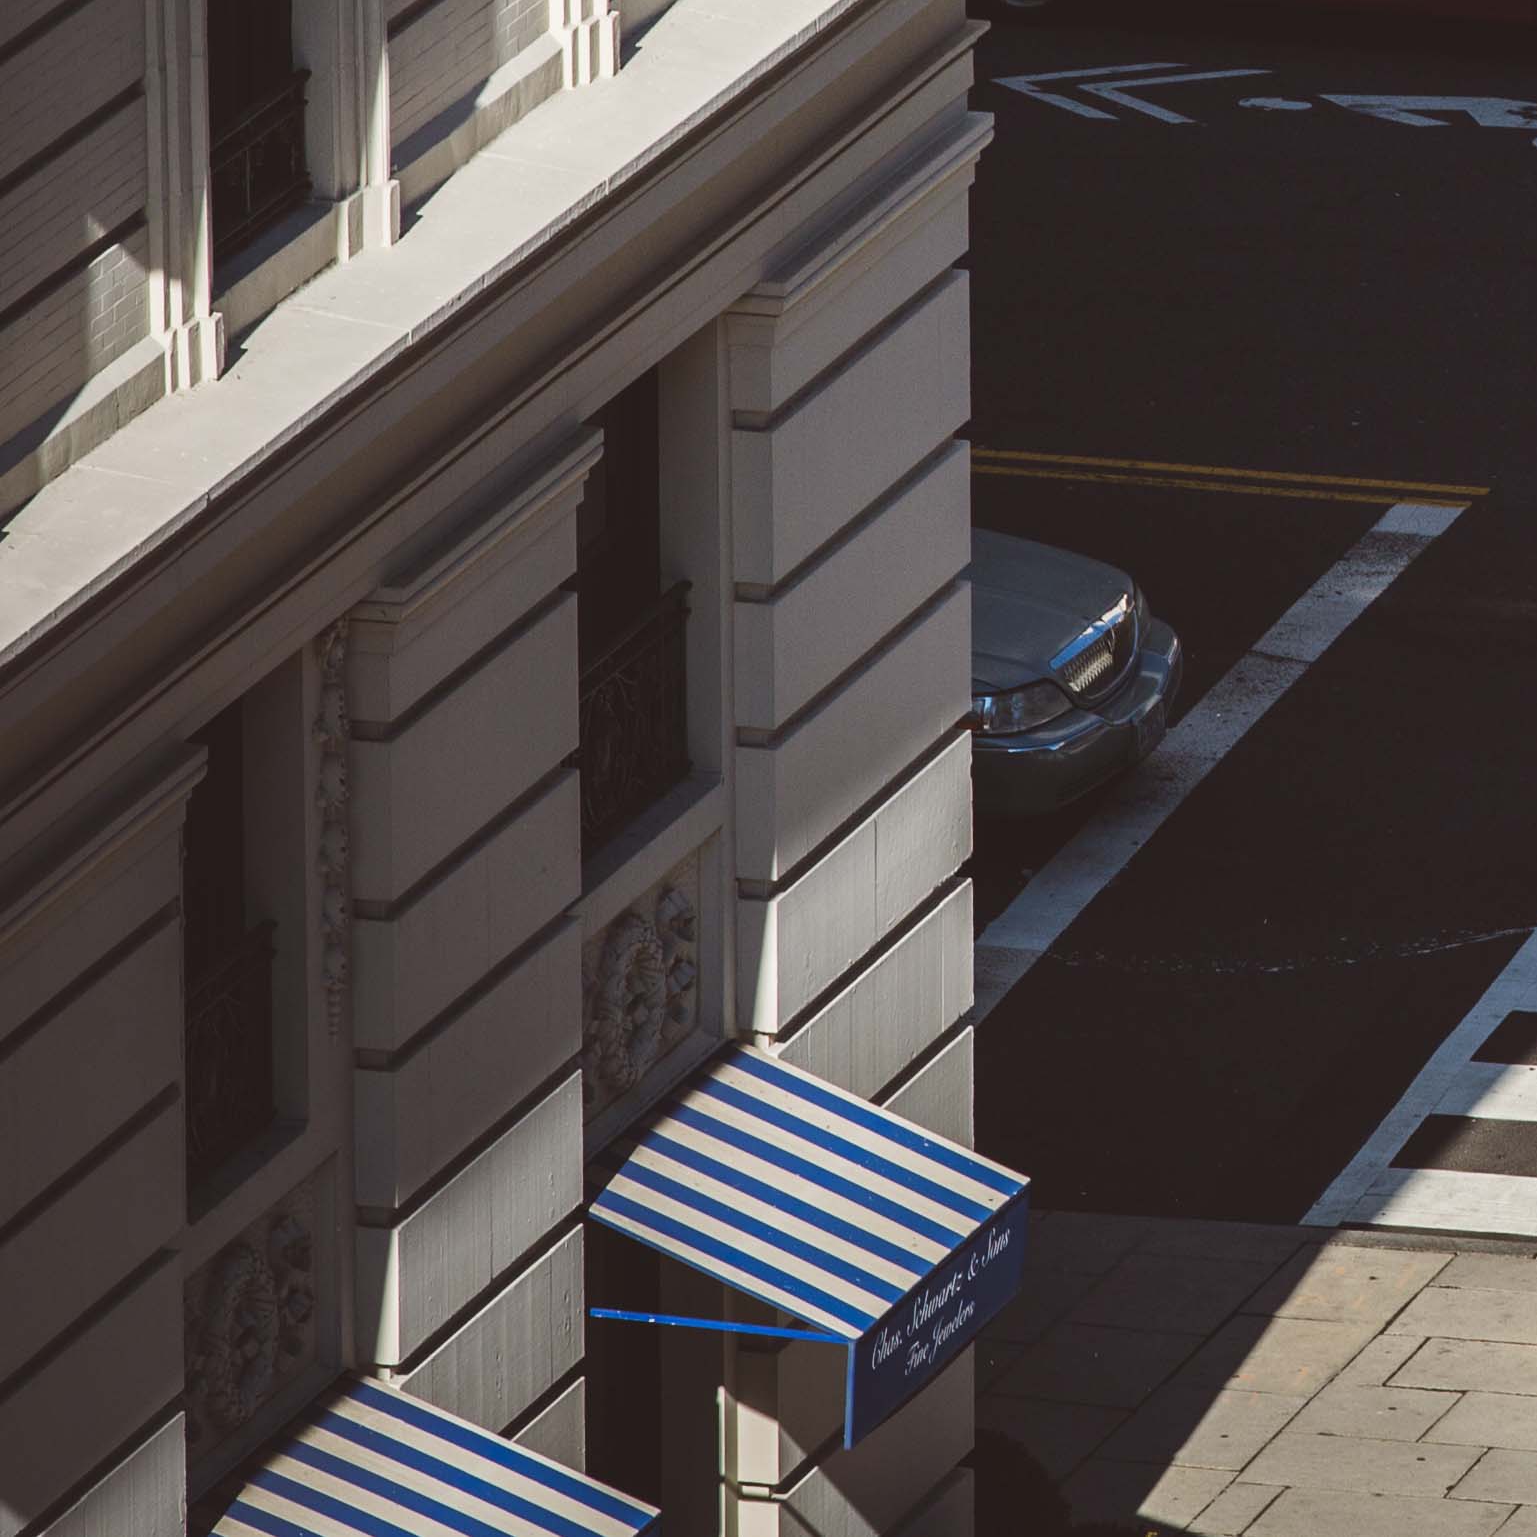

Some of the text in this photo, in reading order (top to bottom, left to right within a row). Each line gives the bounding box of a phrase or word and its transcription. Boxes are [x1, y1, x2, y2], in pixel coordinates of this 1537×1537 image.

[871, 1227, 1011, 1370] Chas. Schwartz & Sons
[904, 1300, 976, 1375] Fine Jewelers
